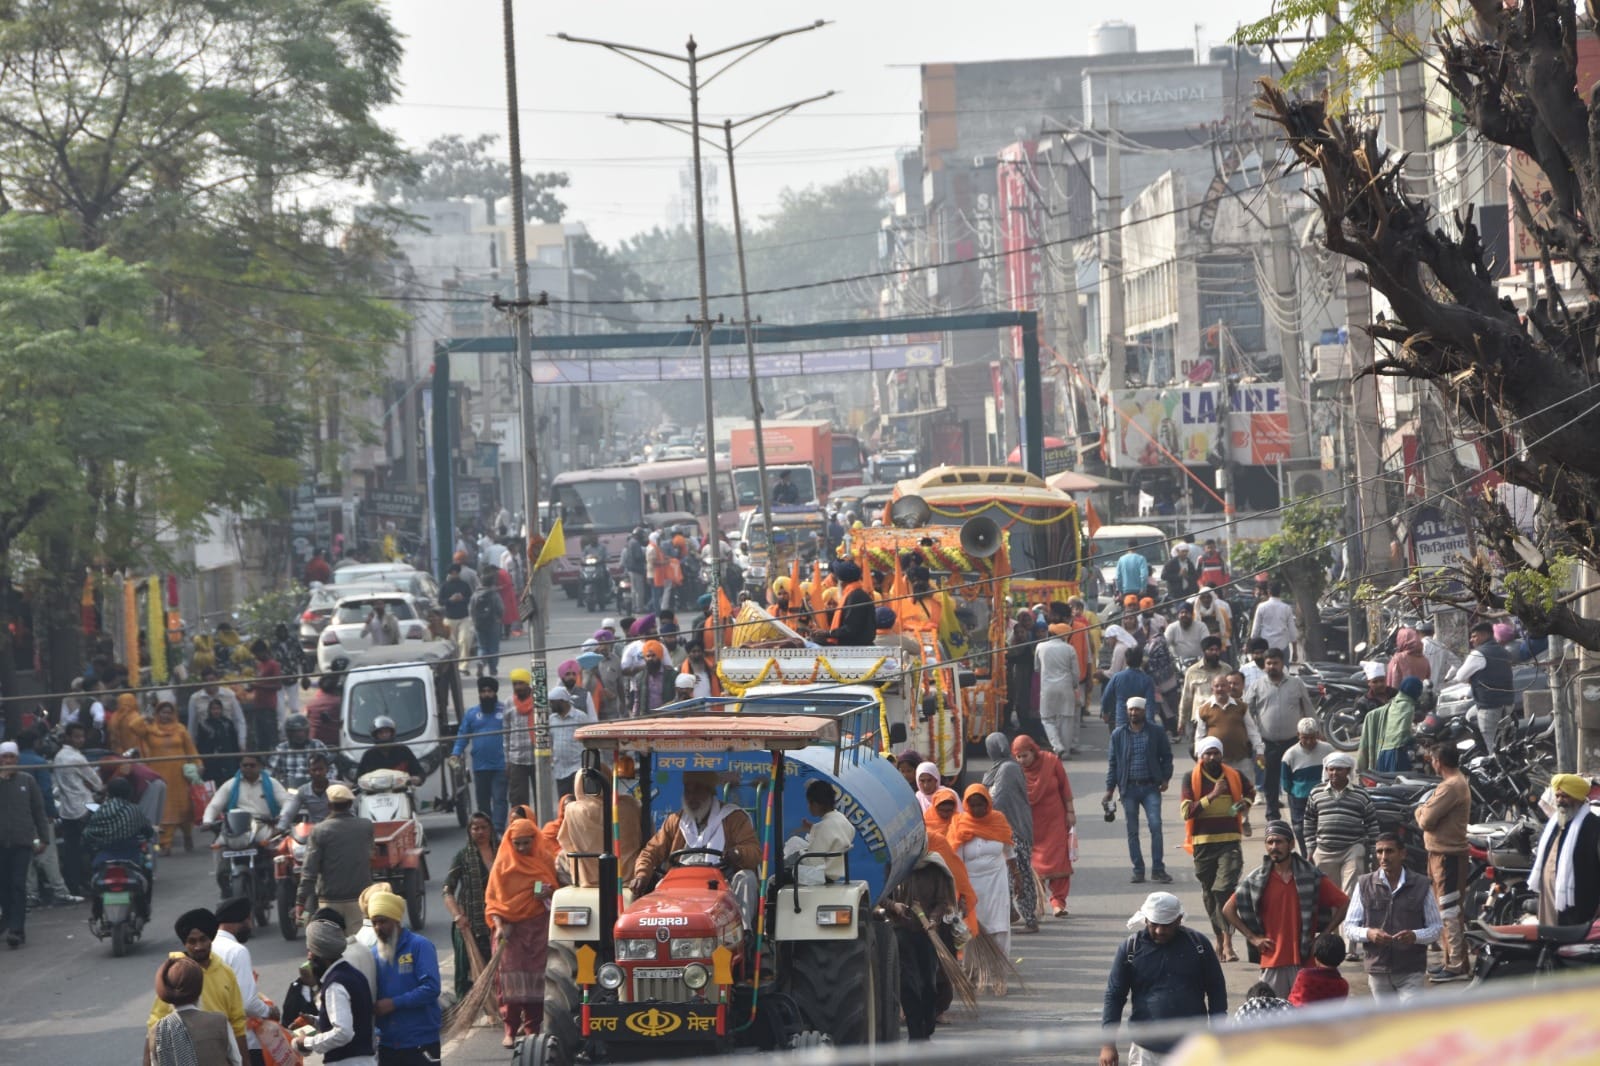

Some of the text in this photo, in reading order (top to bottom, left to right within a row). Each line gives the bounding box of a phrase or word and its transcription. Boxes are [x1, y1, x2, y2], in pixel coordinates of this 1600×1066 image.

[658, 753, 723, 768] ਕਾਰ ਸੇਵਾ
[589, 1012, 717, 1032] ਕਾਰ ਸੇਵਾ
